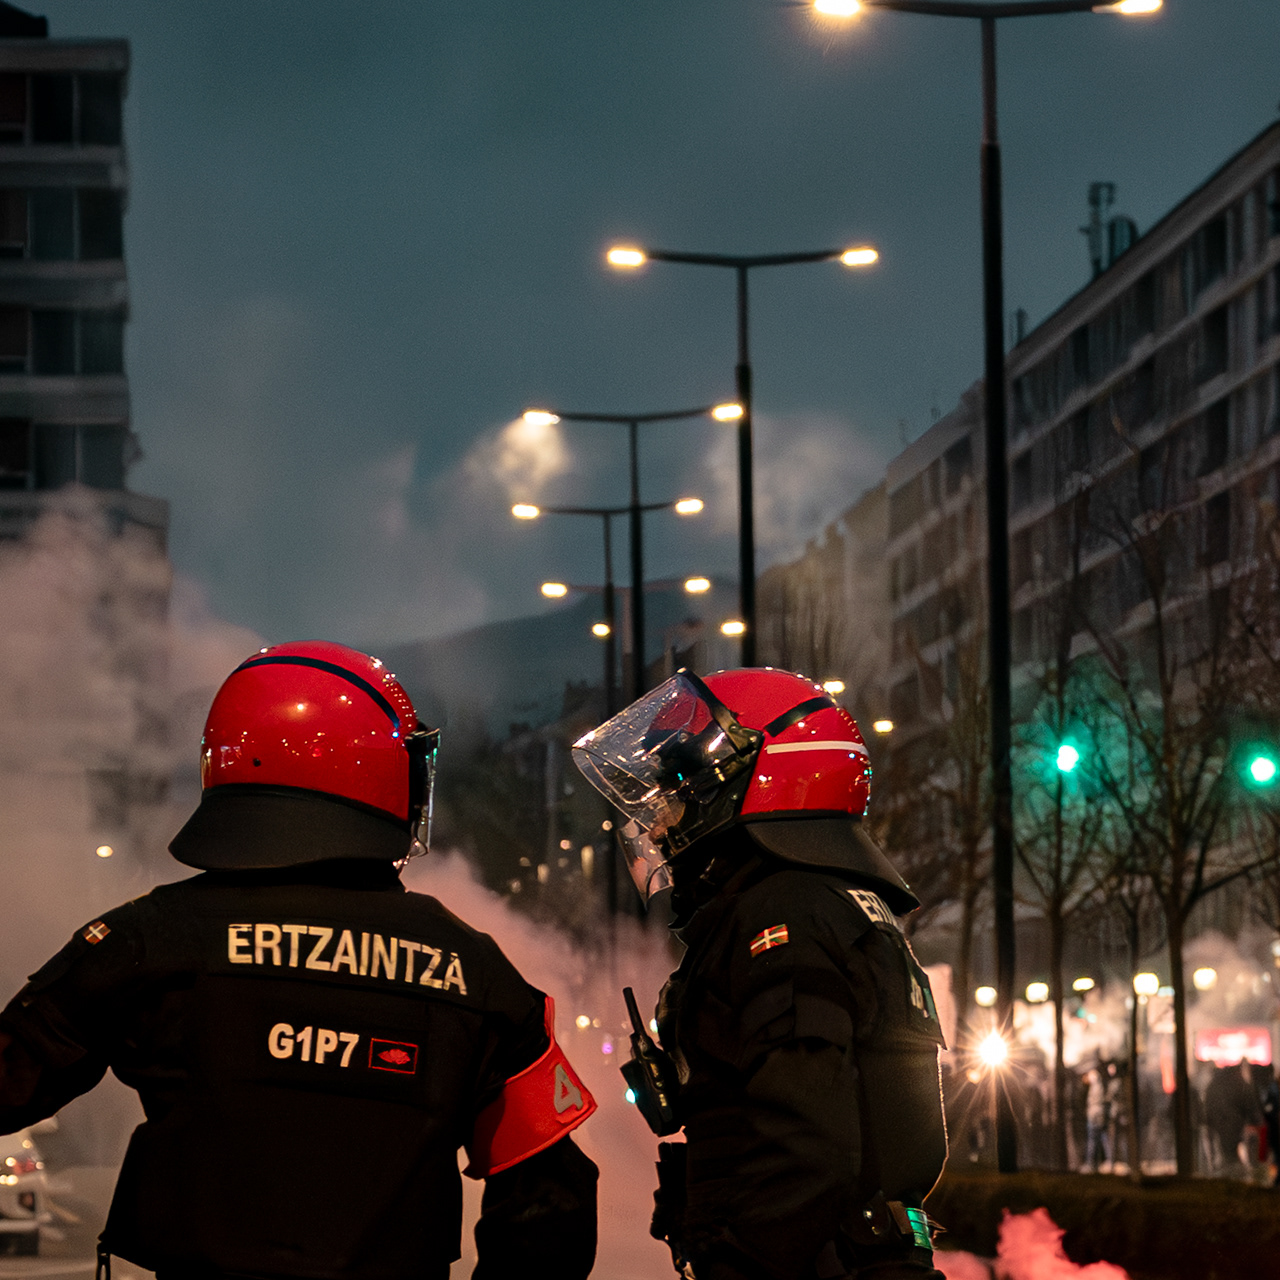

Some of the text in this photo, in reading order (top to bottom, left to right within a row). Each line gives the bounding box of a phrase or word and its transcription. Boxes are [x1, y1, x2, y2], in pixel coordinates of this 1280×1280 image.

[227, 923, 468, 996] ERTZAINTZA
[268, 1023, 360, 1068] G1P7
[553, 1062, 583, 1115] 4
